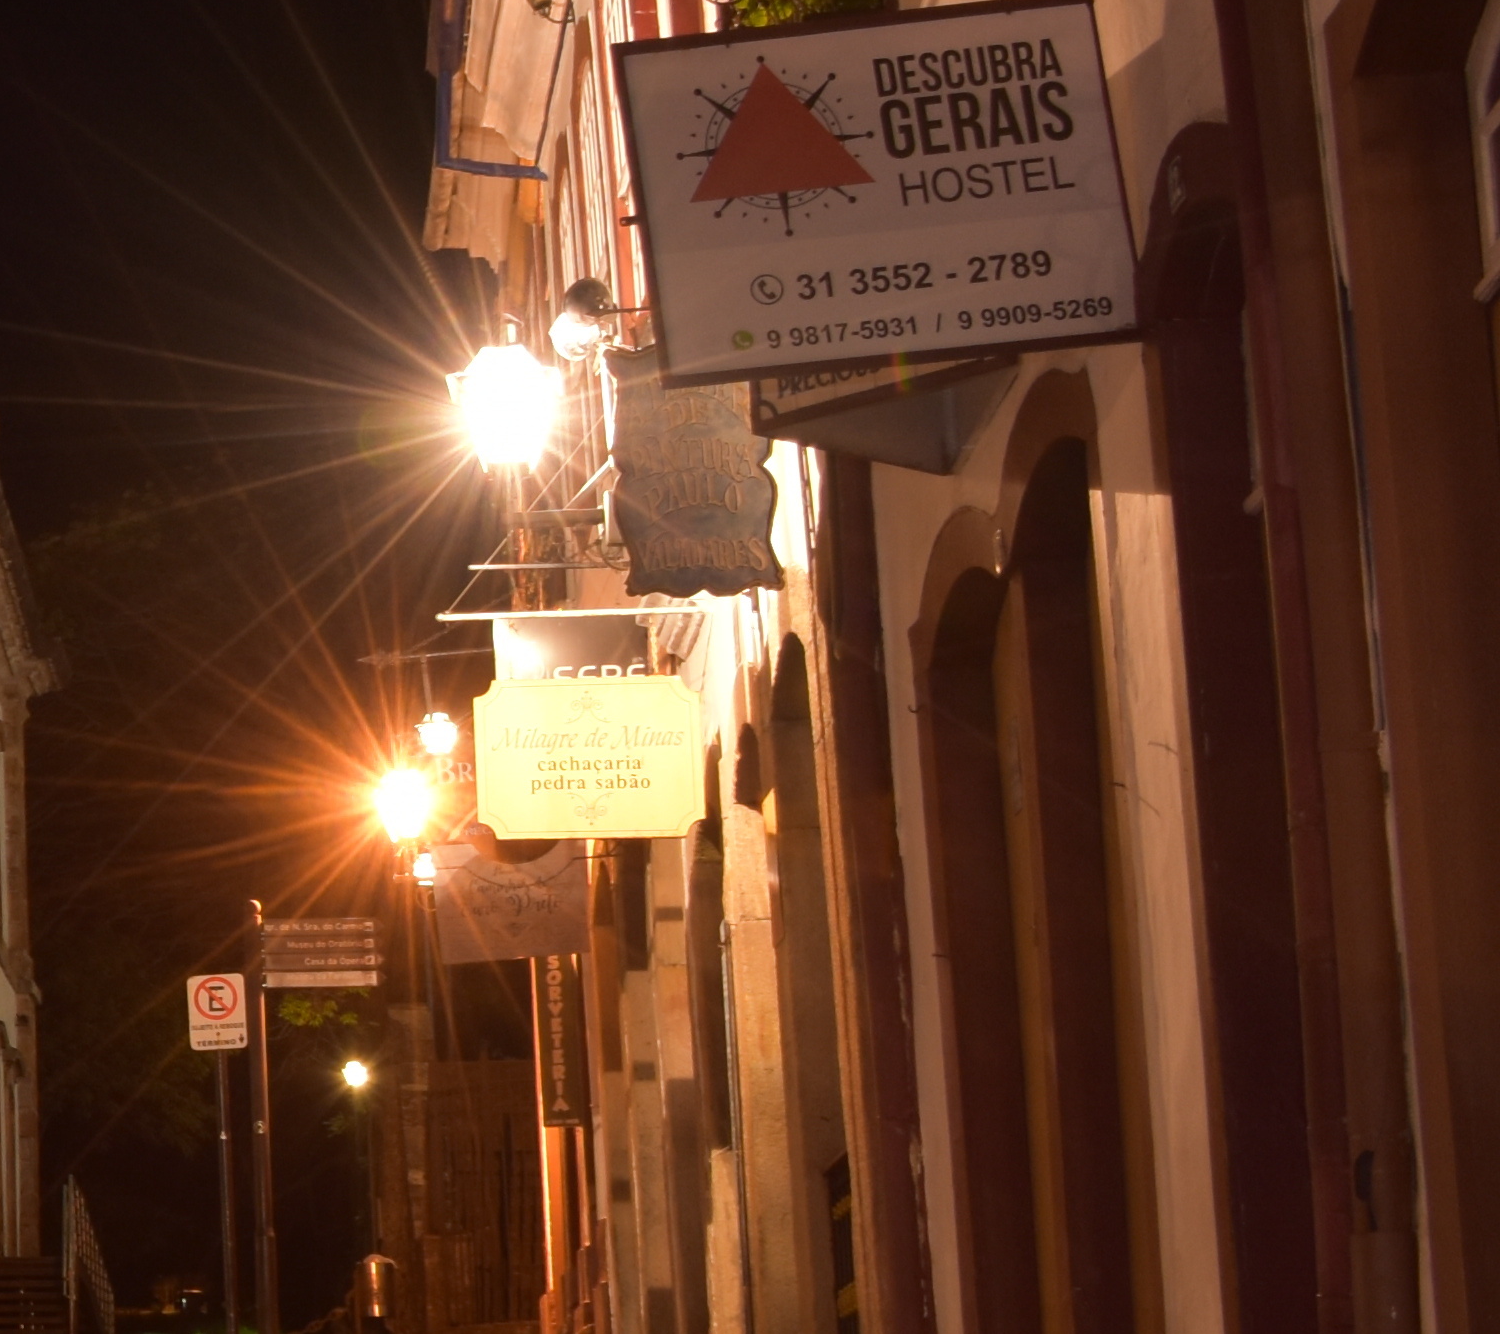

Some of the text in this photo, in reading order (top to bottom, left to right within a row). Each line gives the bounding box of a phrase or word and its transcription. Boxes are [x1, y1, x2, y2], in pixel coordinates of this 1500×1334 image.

[872, 38, 1063, 97] DESCUBRA
[879, 81, 1075, 159] GERAIS
[898, 155, 1076, 207] HOSTEL
[797, 272, 836, 300] 31
[848, 261, 932, 296] 3552
[968, 250, 1052, 285] 2789
[767, 329, 782, 349] 9
[790, 315, 918, 347] 9817-5931
[958, 310, 973, 330] 9
[980, 296, 1113, 328] 9909-5269
[642, 471, 745, 523] PAULO
[492, 725, 685, 755] Milagre de Minas
[537, 755, 642, 775] cachaçaria
[531, 774, 651, 794] pedra sabão
[546, 954, 570, 1112] SORVETERIA
